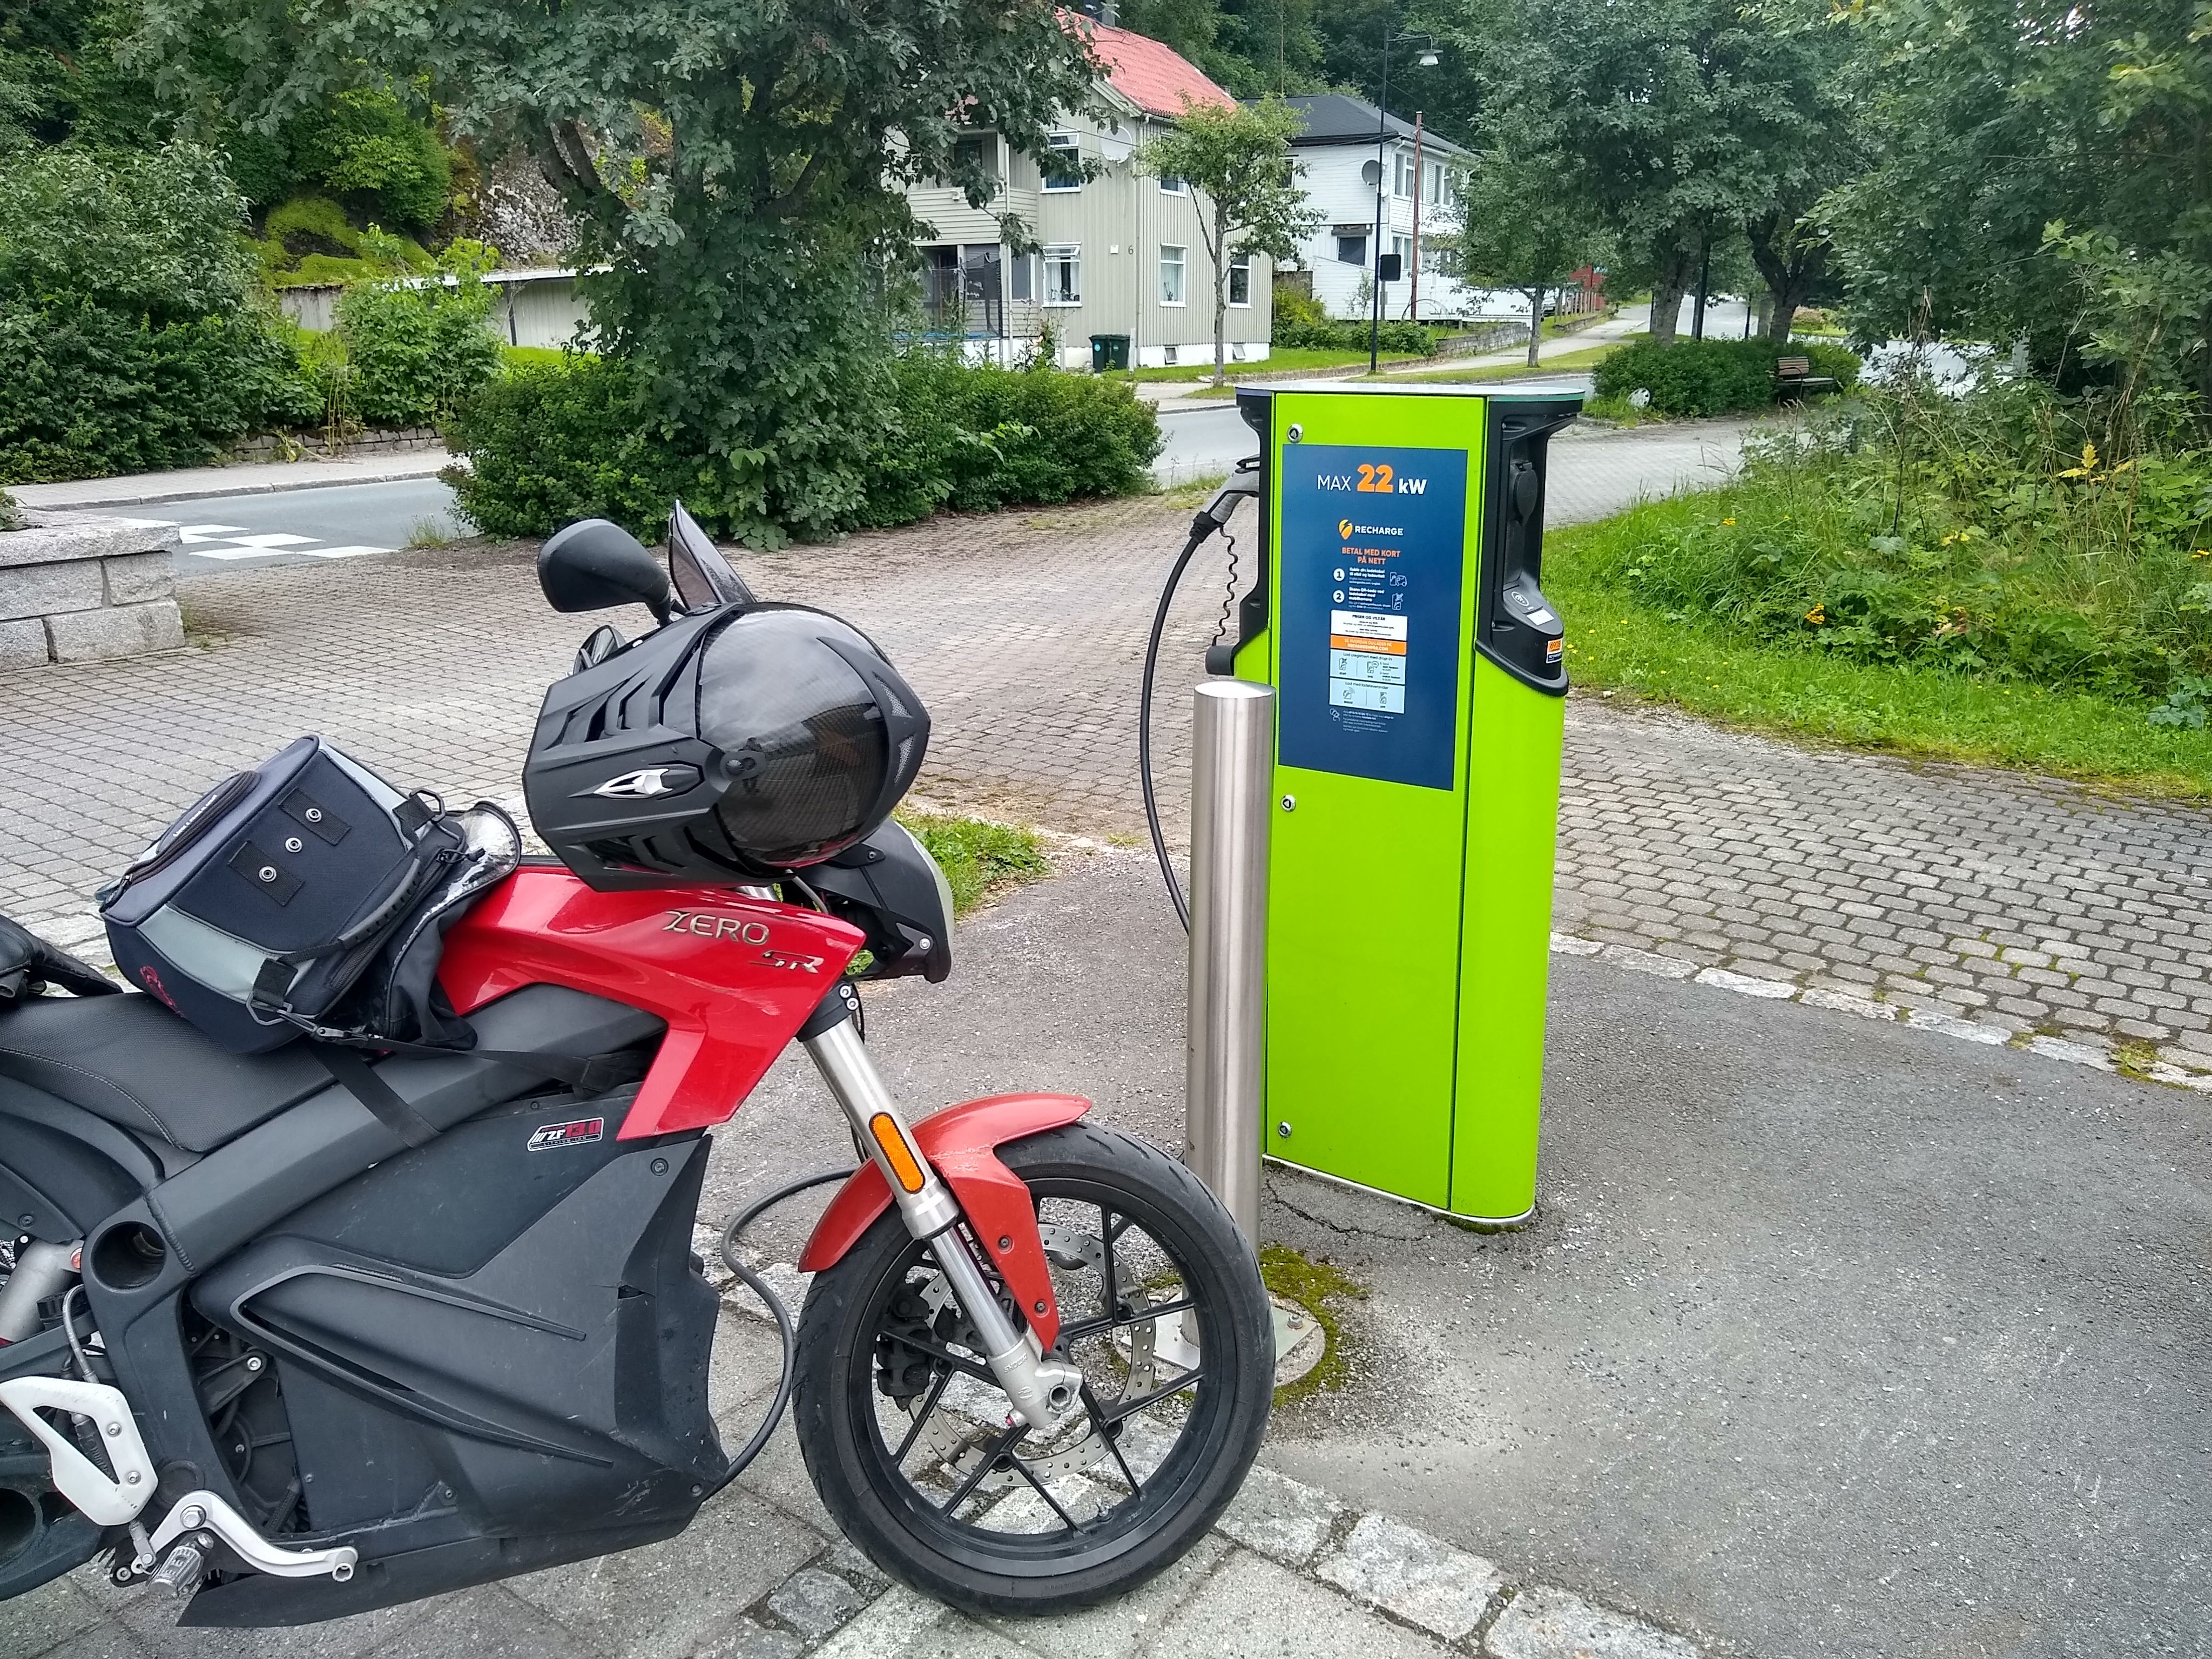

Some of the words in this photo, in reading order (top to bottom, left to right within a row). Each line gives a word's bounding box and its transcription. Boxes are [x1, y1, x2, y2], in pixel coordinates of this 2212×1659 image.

[1128, 245, 1134, 255] 6
[1317, 475, 1351, 491] MAX
[1357, 463, 1393, 493] 22
[1398, 478, 1427, 495] kW
[1354, 525, 1404, 536] RECHARGE
[1342, 547, 1363, 555] BETAL
[662, 909, 770, 946] ZERO
[748, 950, 824, 974] SR
[543, 1136, 586, 1146] LITHIUM-ION
